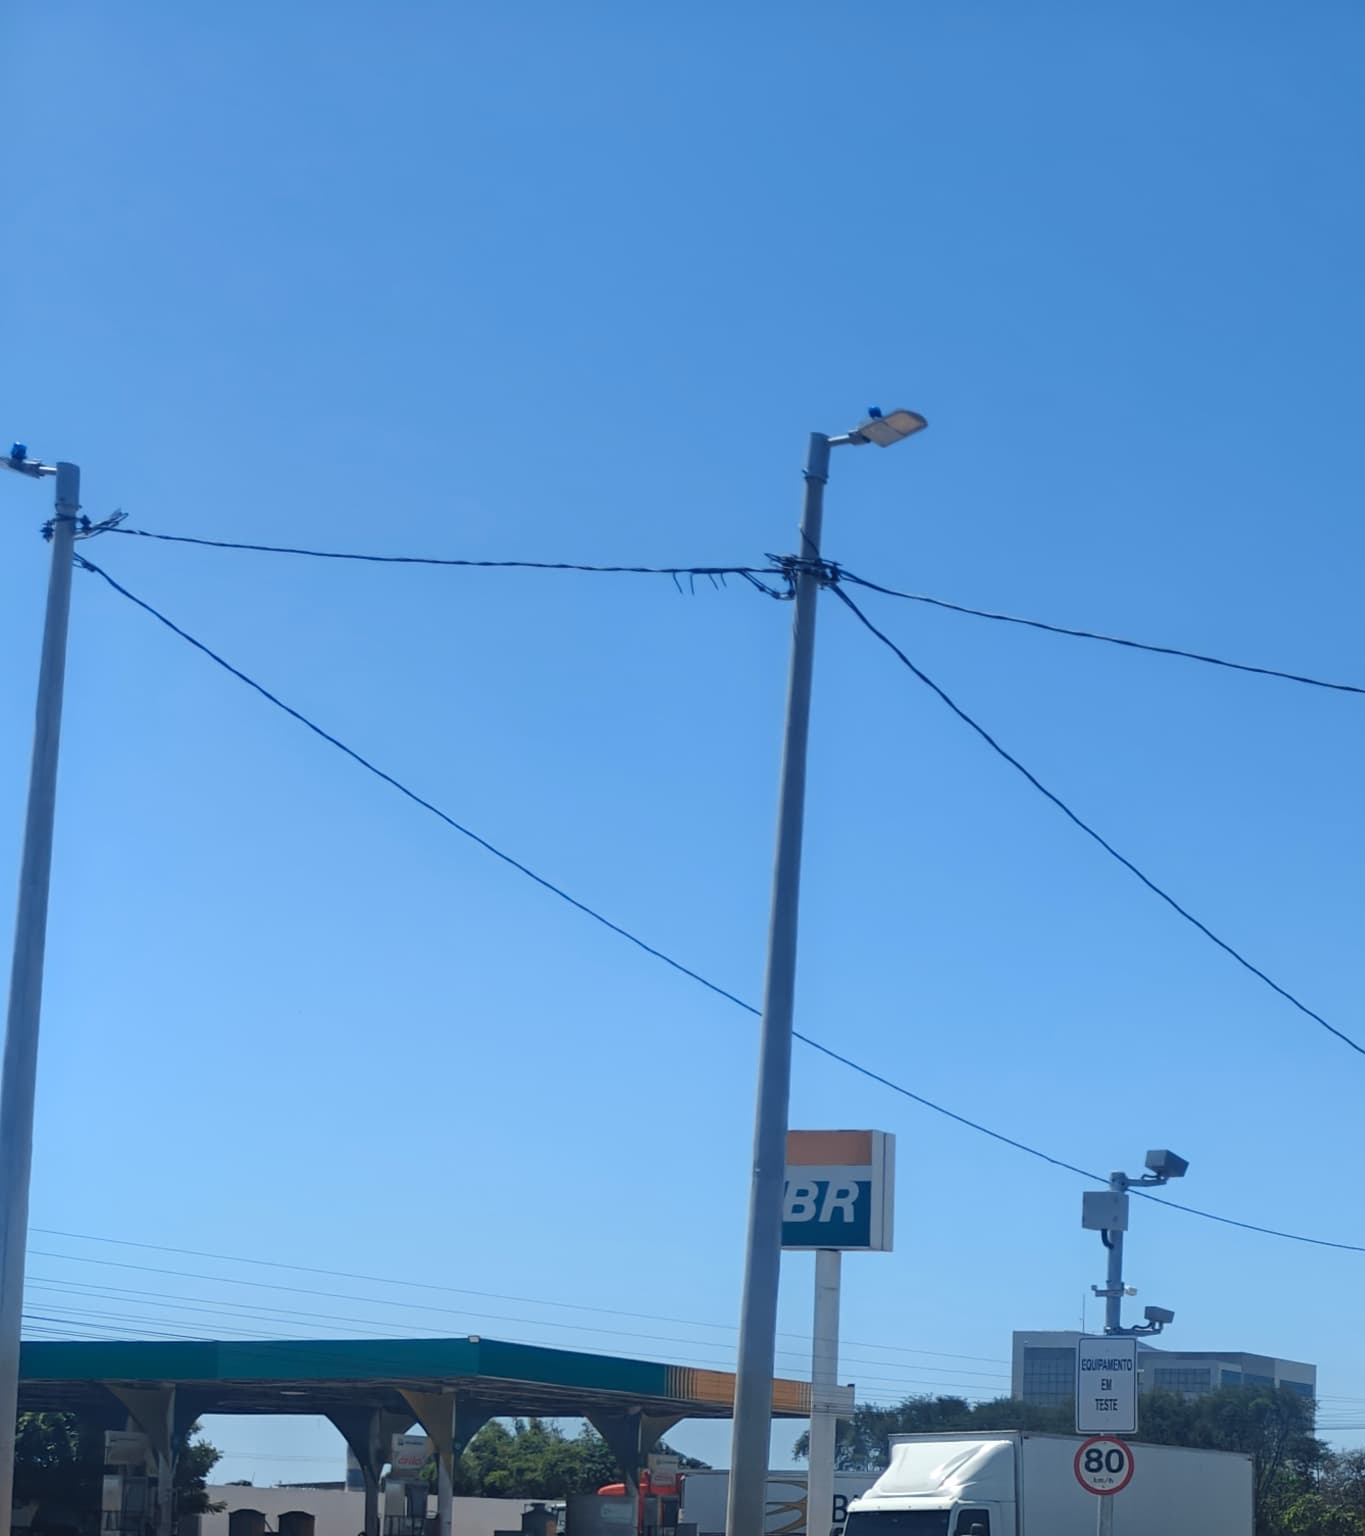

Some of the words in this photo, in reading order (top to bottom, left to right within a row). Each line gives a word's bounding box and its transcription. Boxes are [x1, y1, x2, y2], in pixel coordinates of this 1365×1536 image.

[781, 1179, 860, 1223] BR
[1081, 1359, 1133, 1371] EQUIPAMENTO
[1101, 1378, 1112, 1391] EM
[1095, 1398, 1118, 1411] TESTE
[1084, 1448, 1125, 1473] 80
